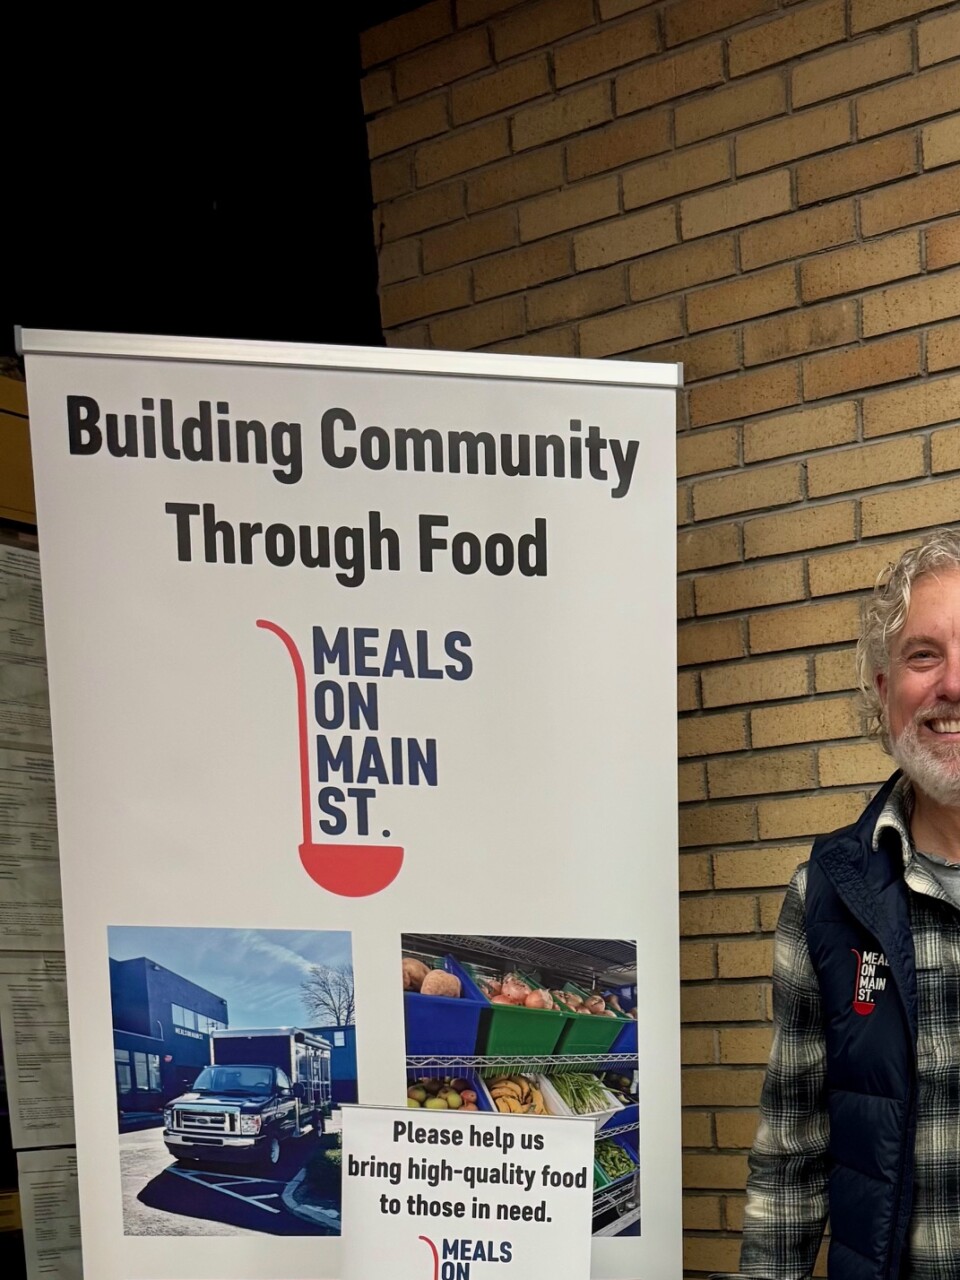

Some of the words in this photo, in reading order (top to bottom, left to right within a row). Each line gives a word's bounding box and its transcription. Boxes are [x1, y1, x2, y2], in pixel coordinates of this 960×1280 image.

[66, 395, 302, 484] Building
[320, 408, 639, 498] Community
[165, 503, 400, 587] Through
[419, 514, 547, 577] Food
[312, 626, 473, 681] MEALS
[314, 681, 378, 731] ON
[316, 735, 438, 786] MAIN
[317, 786, 391, 838] ST.
[861, 964, 876, 976] ON
[862, 951, 890, 966] MEAL
[858, 988, 874, 1002] ST.
[860, 976, 886, 990] MAIN
[393, 1120, 464, 1149] Please
[470, 1125, 514, 1154] help
[520, 1133, 544, 1150] us
[348, 1154, 402, 1185] bring
[408, 1157, 535, 1188] high-quality
[541, 1165, 587, 1189] food
[380, 1194, 401, 1214] to
[407, 1195, 465, 1219] those
[472, 1198, 490, 1219] in
[497, 1200, 552, 1222] need.
[442, 1238, 512, 1263] MEALS
